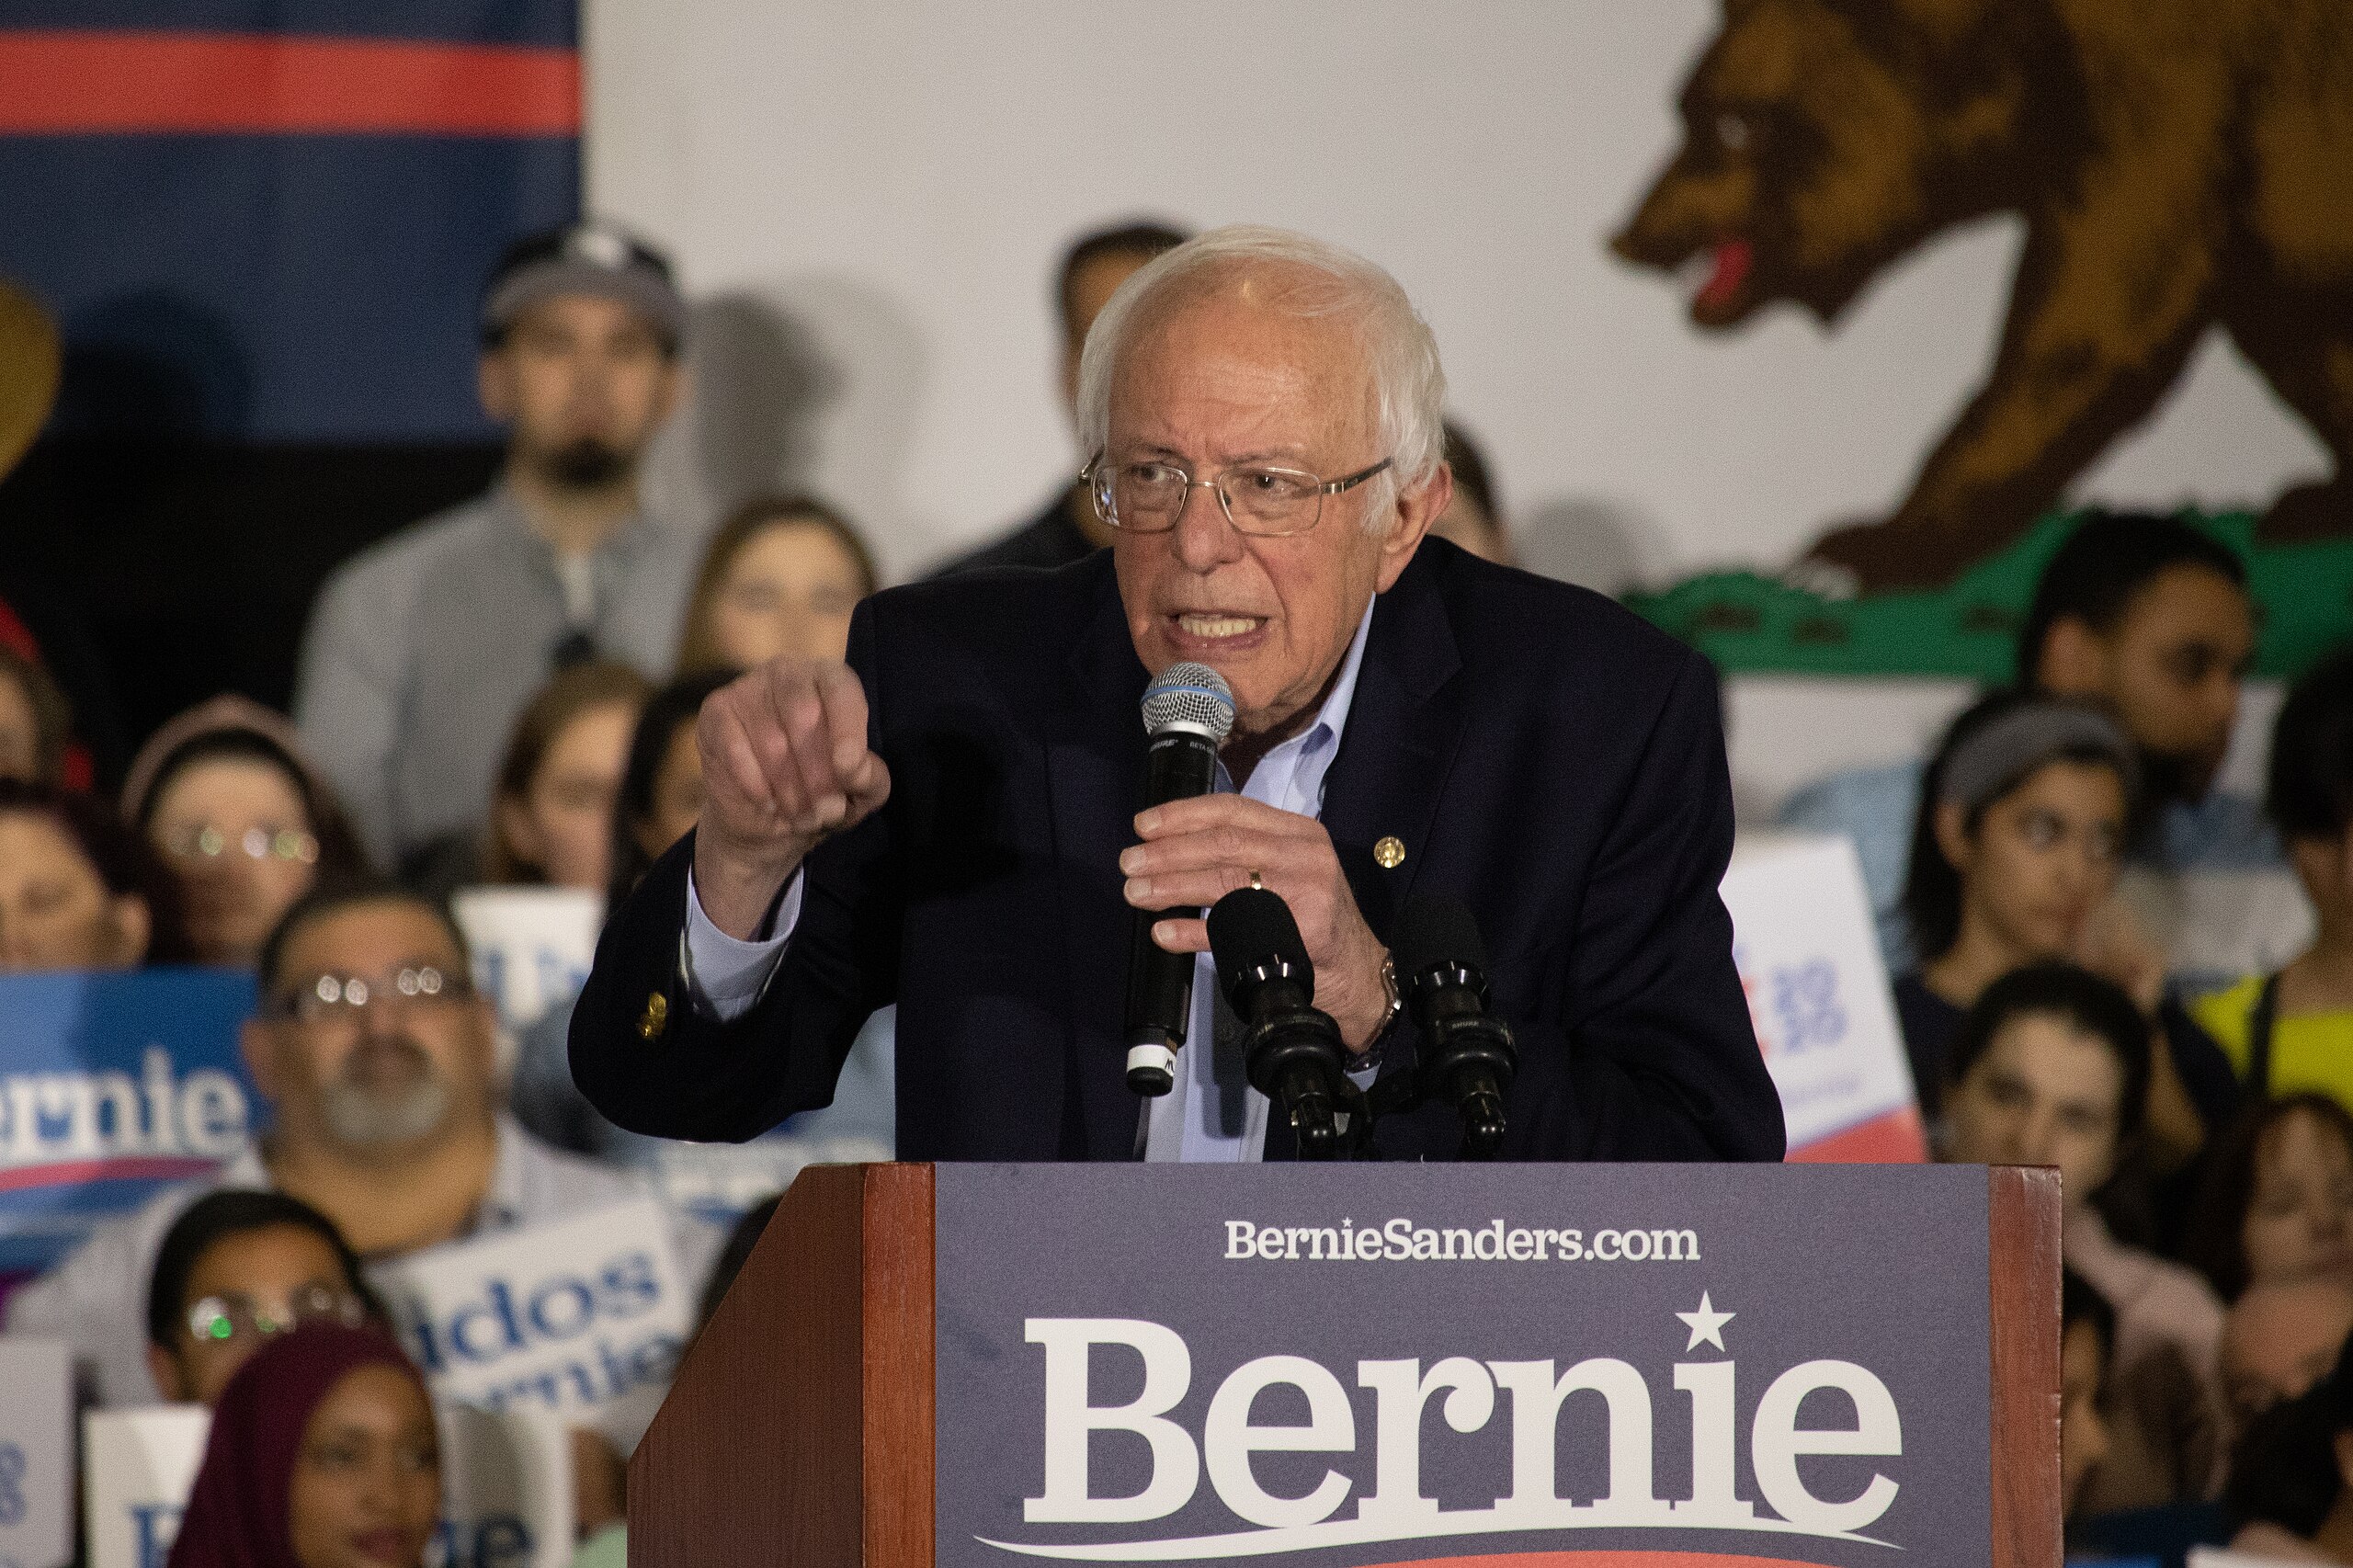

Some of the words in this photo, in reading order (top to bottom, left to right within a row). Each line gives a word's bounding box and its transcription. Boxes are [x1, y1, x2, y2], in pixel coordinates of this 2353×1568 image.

[0, 1044, 246, 1156] rnie
[1224, 1216, 1701, 1261] BernieSanders.com
[1023, 1290, 1903, 1531] Bernie
